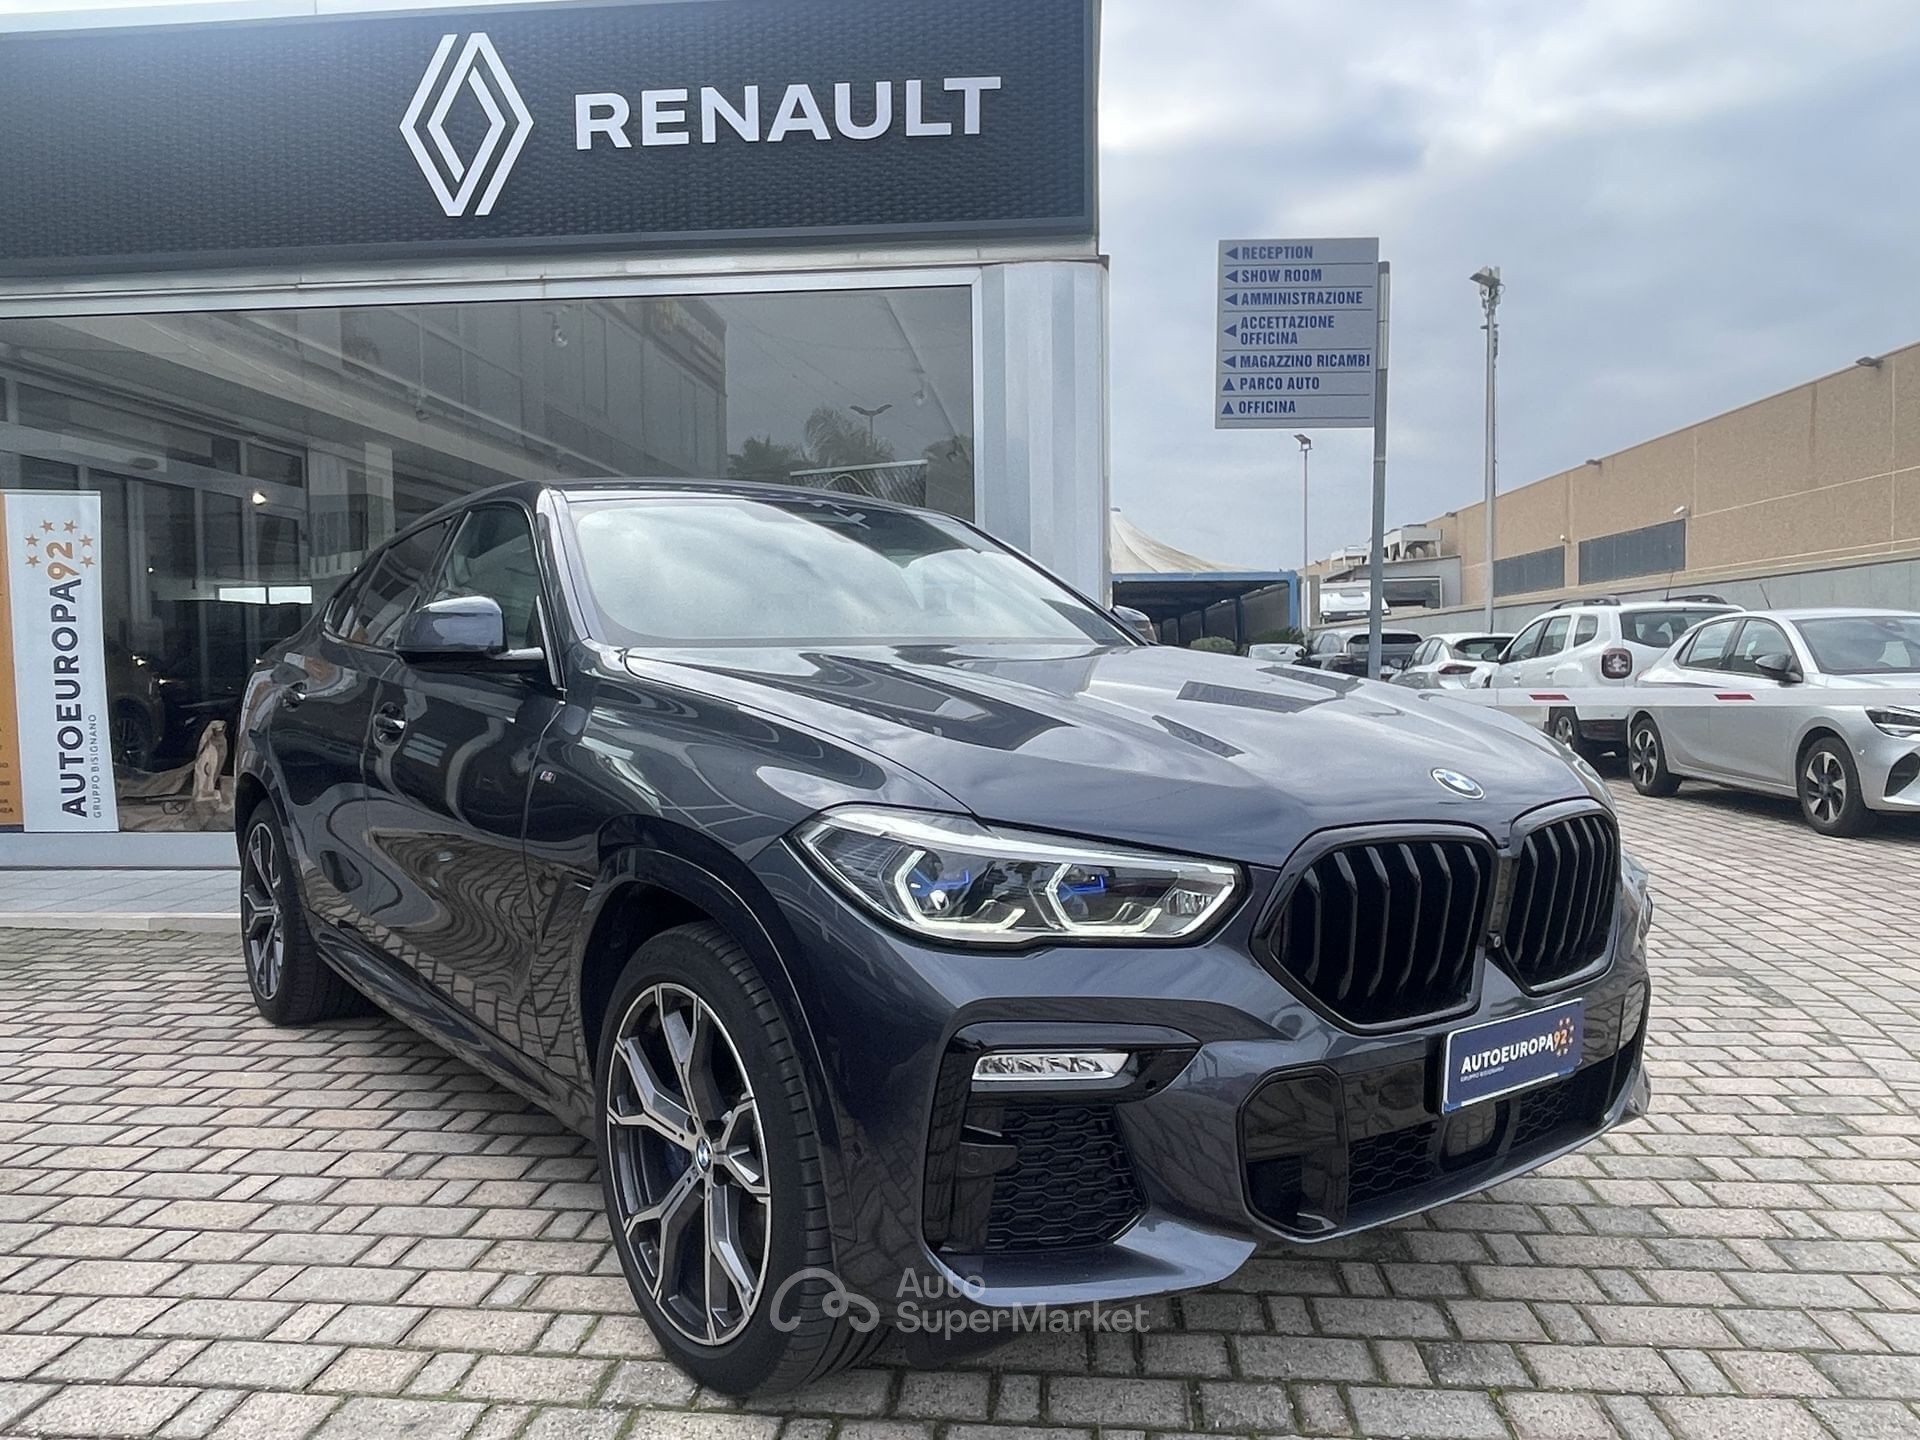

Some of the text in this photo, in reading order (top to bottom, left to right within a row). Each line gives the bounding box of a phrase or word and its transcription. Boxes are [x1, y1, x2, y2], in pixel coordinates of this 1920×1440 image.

[575, 76, 1001, 150] RENAULT
[1241, 246, 1313, 259] RECEPTION
[1241, 268, 1322, 282] SHOW ROOM
[1241, 291, 1363, 306] AMMINISTRAZIONE
[1240, 315, 1335, 329] ACCETTAZIONE
[1240, 331, 1298, 345] OFFICINA
[1239, 354, 1370, 368] MAGAZZINO RICAMBI
[1239, 377, 1320, 390] PARCO AUTO
[1238, 400, 1296, 414] OFFICINA
[46, 541, 88, 818] AUTOEUROPA92
[88, 714, 102, 819] GRUPPO BISIGNANO
[1460, 1029, 1568, 1074] AUTOEUROPA92
